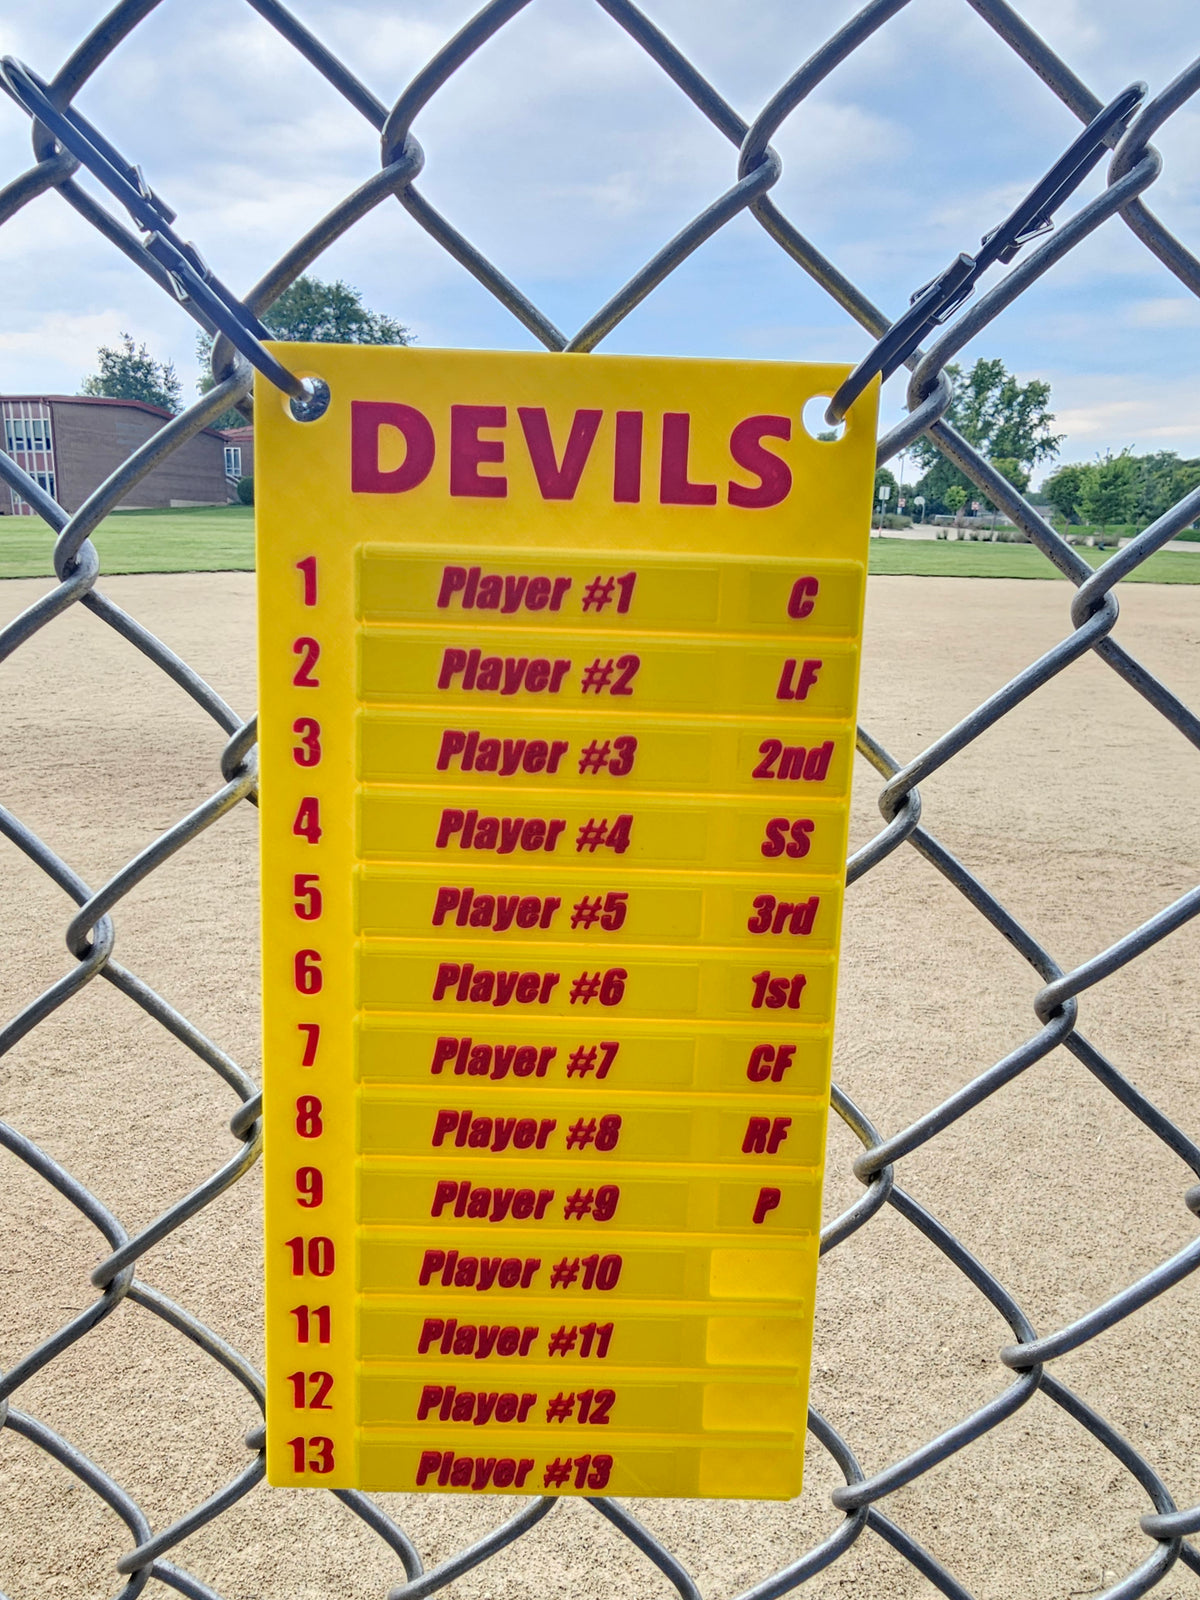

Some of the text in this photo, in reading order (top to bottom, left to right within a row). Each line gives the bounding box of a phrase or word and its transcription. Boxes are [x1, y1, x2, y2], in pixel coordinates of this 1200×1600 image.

[351, 401, 792, 508] DEVILS
[295, 555, 820, 620] 1 Player #1 C
[292, 636, 823, 701] 2 Player #2 LF
[292, 717, 835, 782] 3 Player #3 2nd
[292, 796, 815, 859] 4 Player #4 SS
[293, 873, 820, 936] 5 Player #5 3rd
[294, 949, 807, 1010] 6 Player #6 1st
[297, 1023, 797, 1083] 7 Player #7 CF
[295, 1095, 793, 1155] 8 Player #8 RF
[295, 1166, 782, 1225] 9 Player #9 P
[284, 1236, 623, 1292] 10 Player #10
[289, 1304, 615, 1360] 11 Player #11
[286, 1370, 617, 1427] 12 Player #12
[286, 1436, 614, 1492] 13 Player #13
